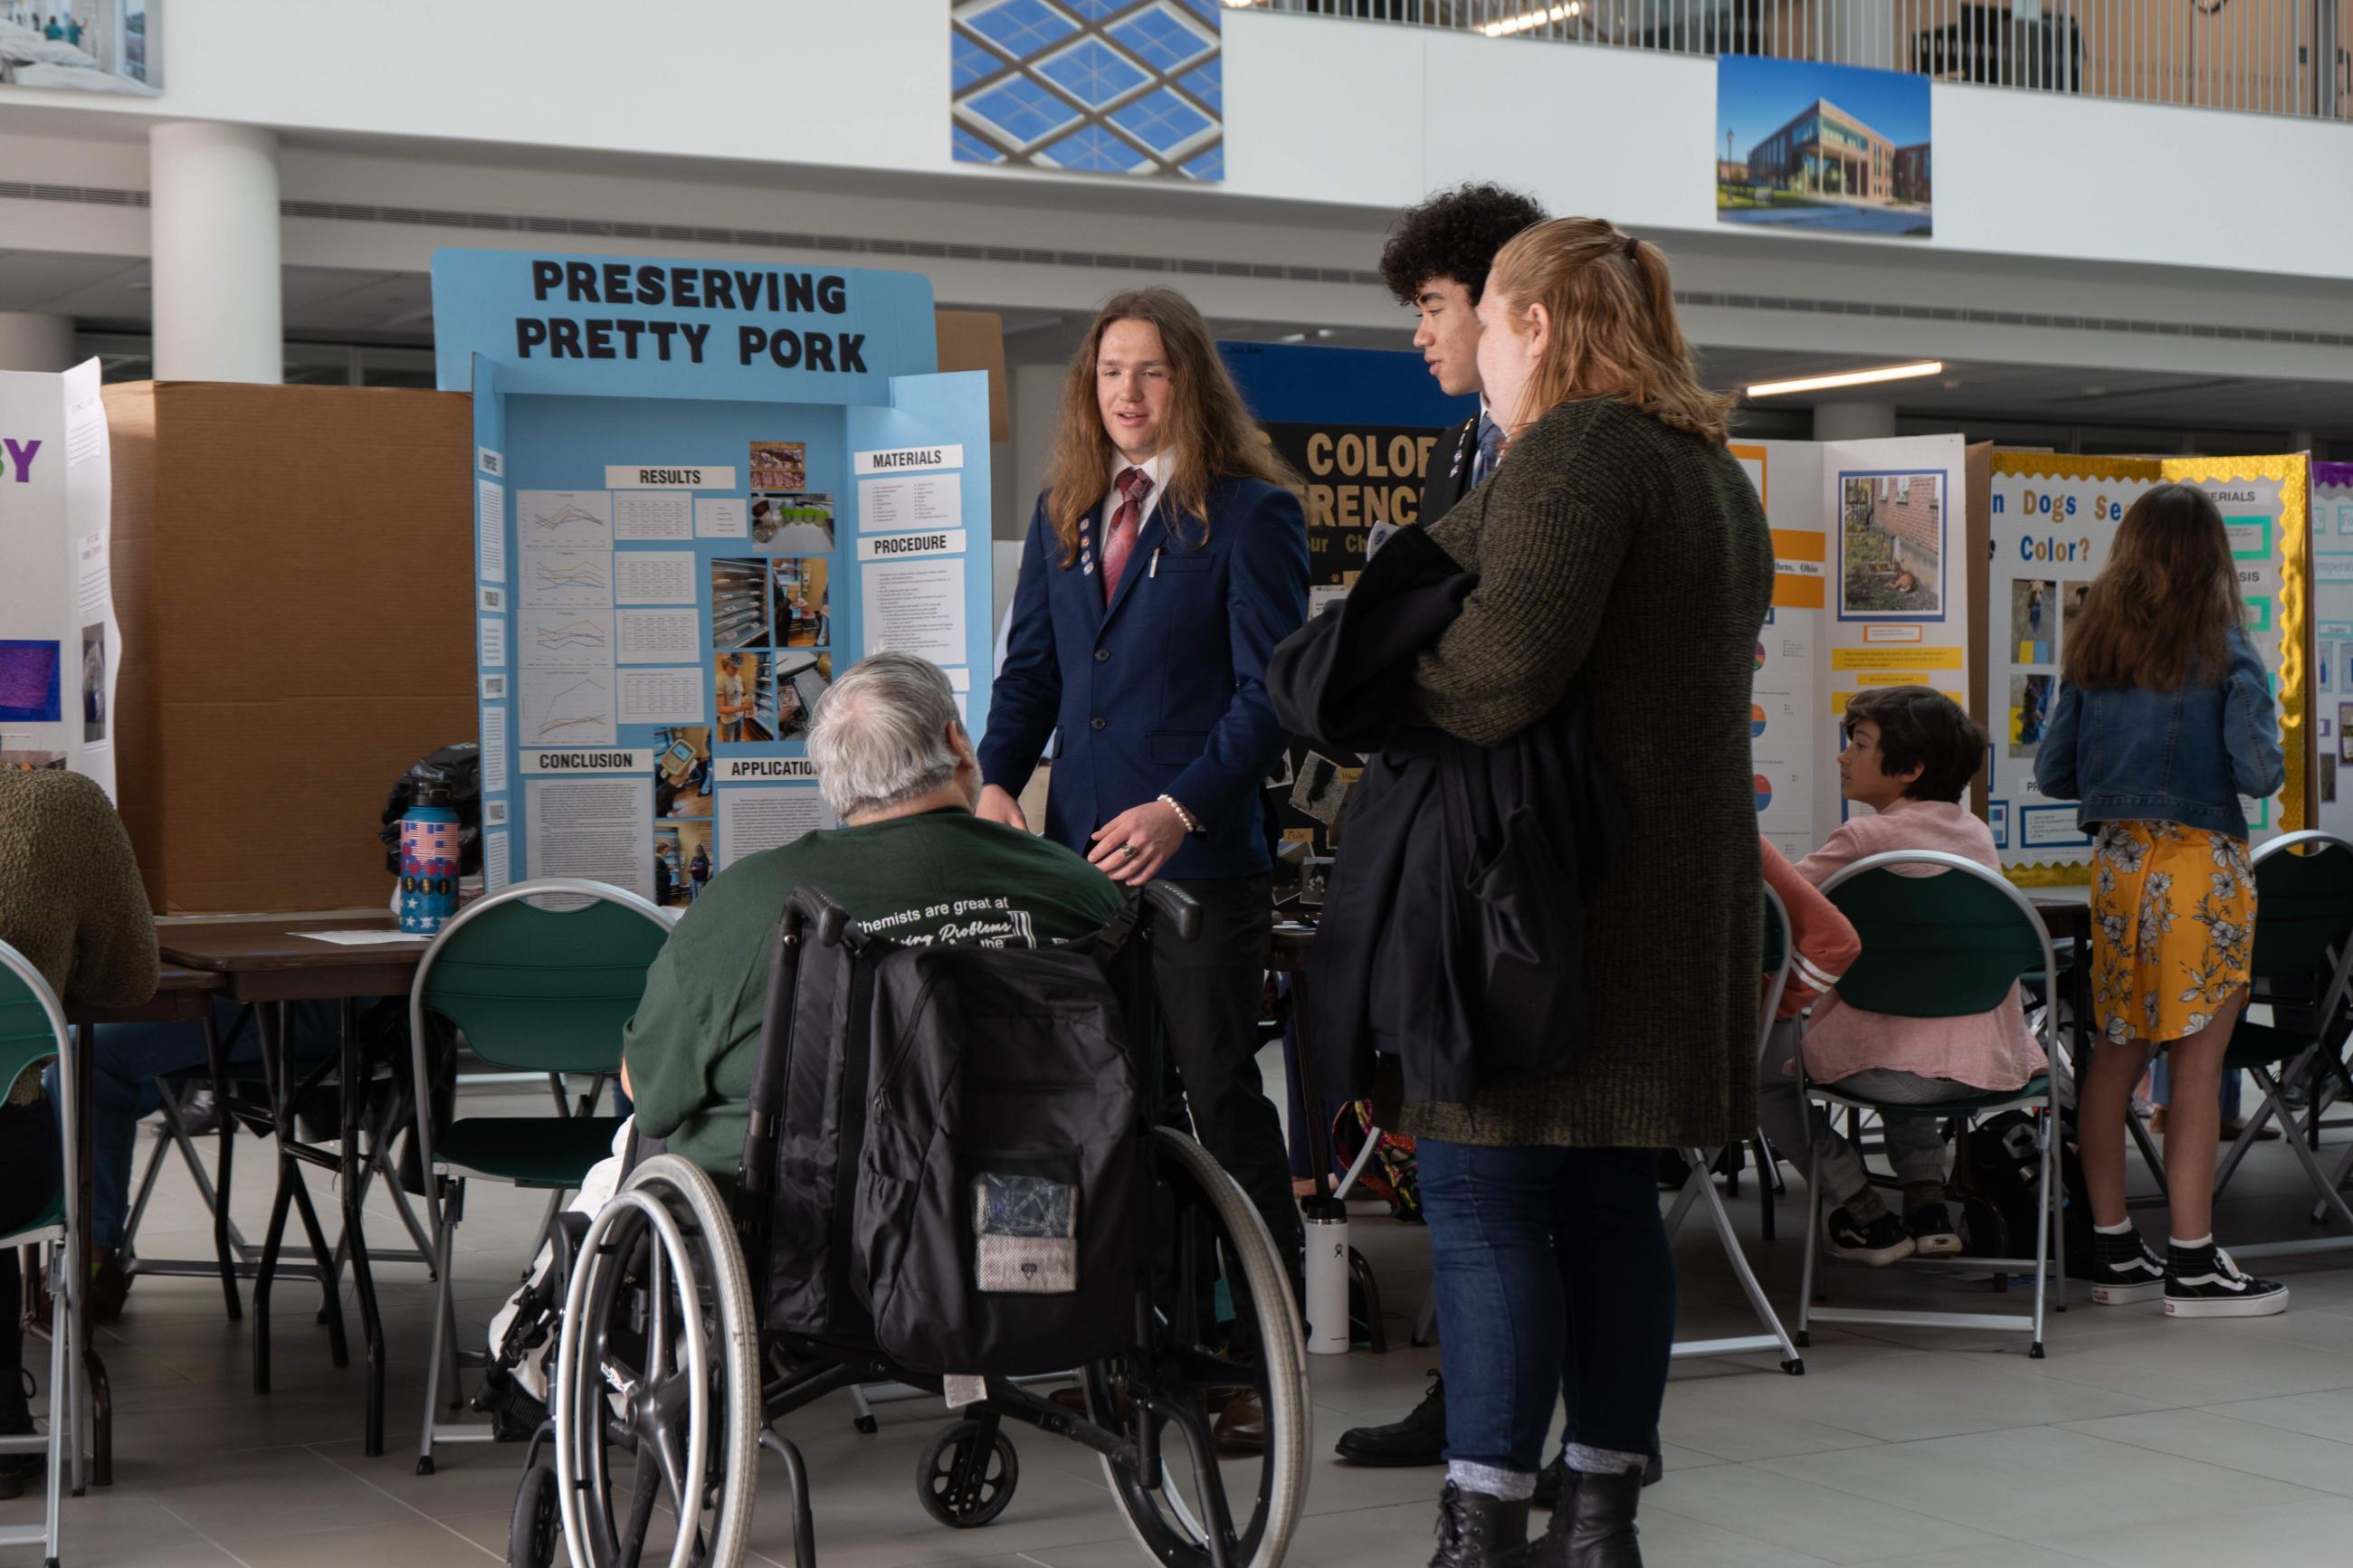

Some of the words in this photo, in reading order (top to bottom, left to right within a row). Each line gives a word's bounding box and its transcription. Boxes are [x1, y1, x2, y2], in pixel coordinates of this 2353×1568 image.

[532, 261, 847, 315] PRESERVING
[515, 318, 710, 364] PRETTY
[738, 326, 868, 374] PORK
[0, 438, 43, 482] Y
[873, 450, 941, 469] MATERIALS
[639, 470, 701, 484] RESULTS
[2023, 489, 2077, 523] Dogs
[874, 535, 947, 554] PROCEDURE
[2020, 535, 2091, 561] Color?
[539, 753, 634, 769] CONCLUSION
[731, 761, 817, 776] APPLICATIO
[858, 908, 921, 934] hemists
[925, 902, 949, 918] are
[953, 898, 992, 916] great
[995, 896, 1009, 909] at
[938, 920, 1013, 942] Problems
